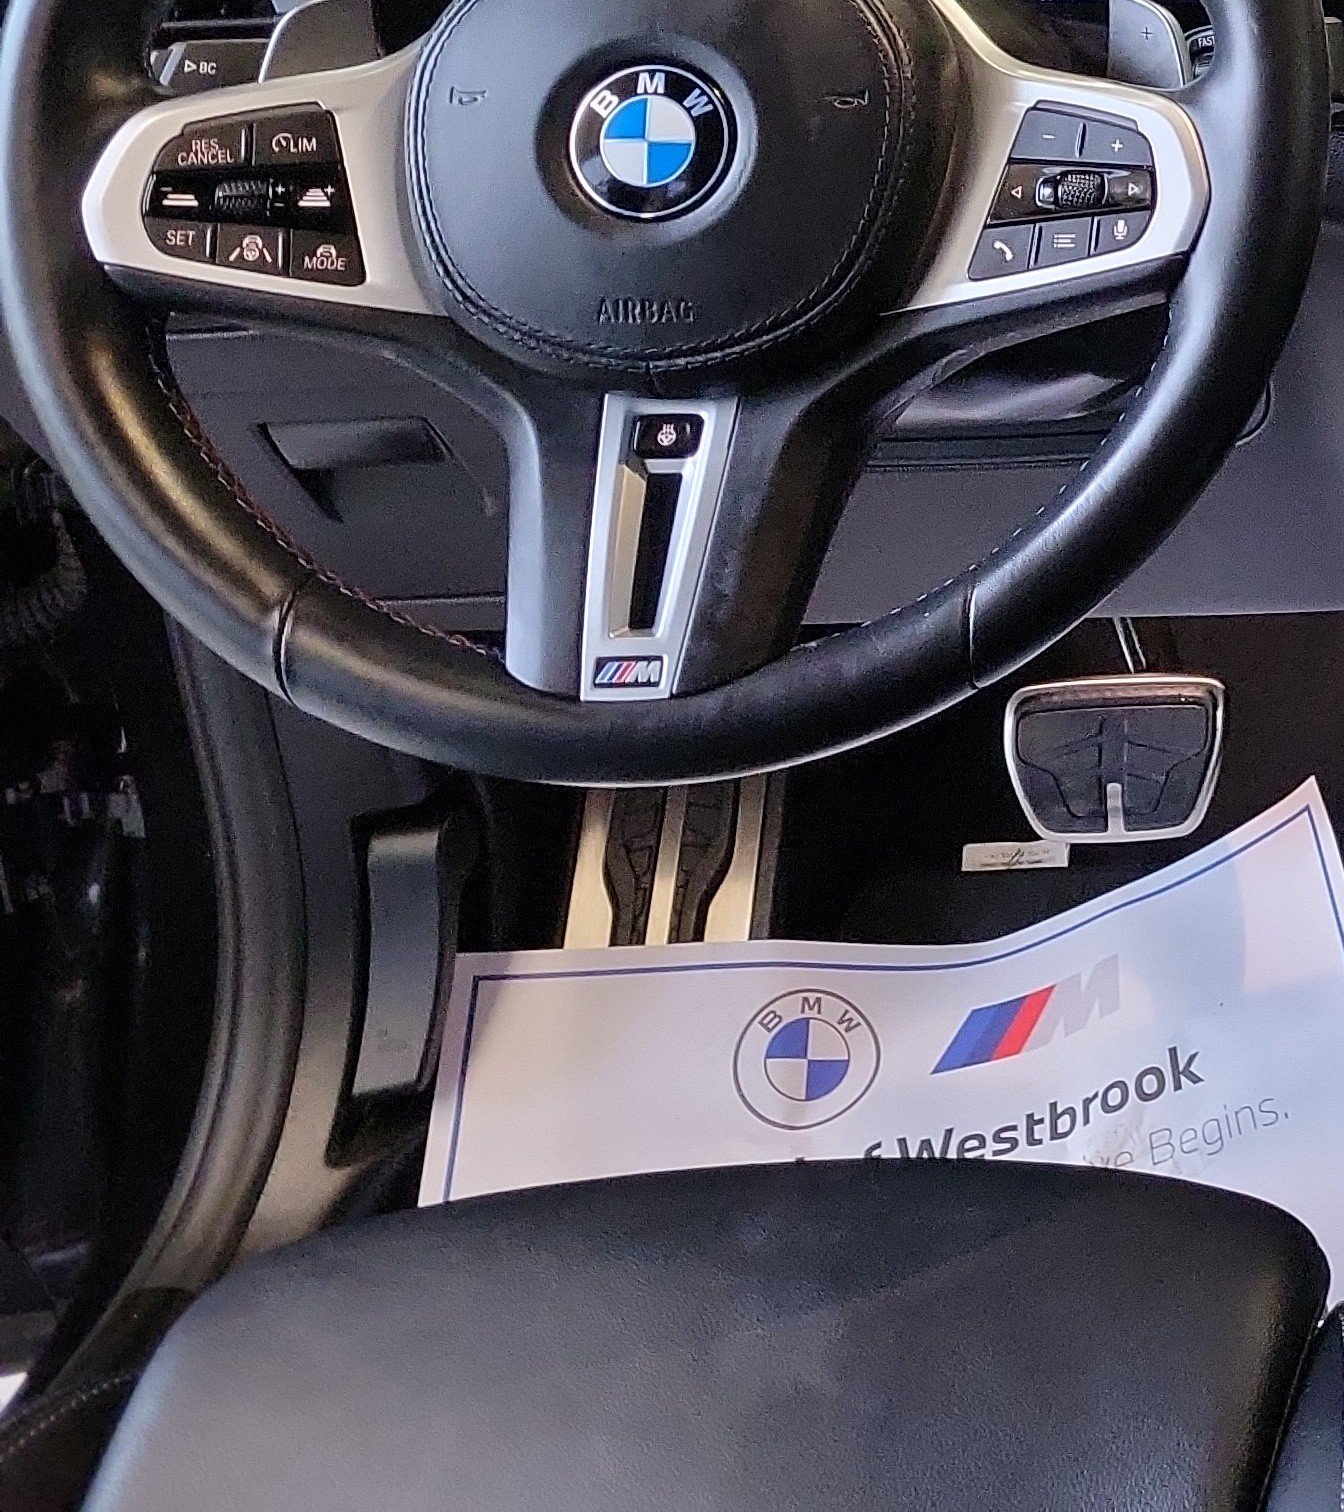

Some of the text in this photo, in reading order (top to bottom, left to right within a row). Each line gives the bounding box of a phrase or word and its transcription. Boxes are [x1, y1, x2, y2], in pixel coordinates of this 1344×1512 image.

[199, 60, 218, 76] BC
[590, 71, 714, 119] BMW
[191, 138, 219, 152] RES
[290, 136, 318, 154] LIM
[177, 147, 235, 166] CANCEL
[165, 229, 196, 247] SET
[303, 254, 347, 271] MODE
[598, 296, 697, 325] AIRBAG
[758, 995, 862, 1034] BMW
[895, 1045, 1206, 1161] Westbrook
[1148, 1096, 1291, 1167] Begins.
